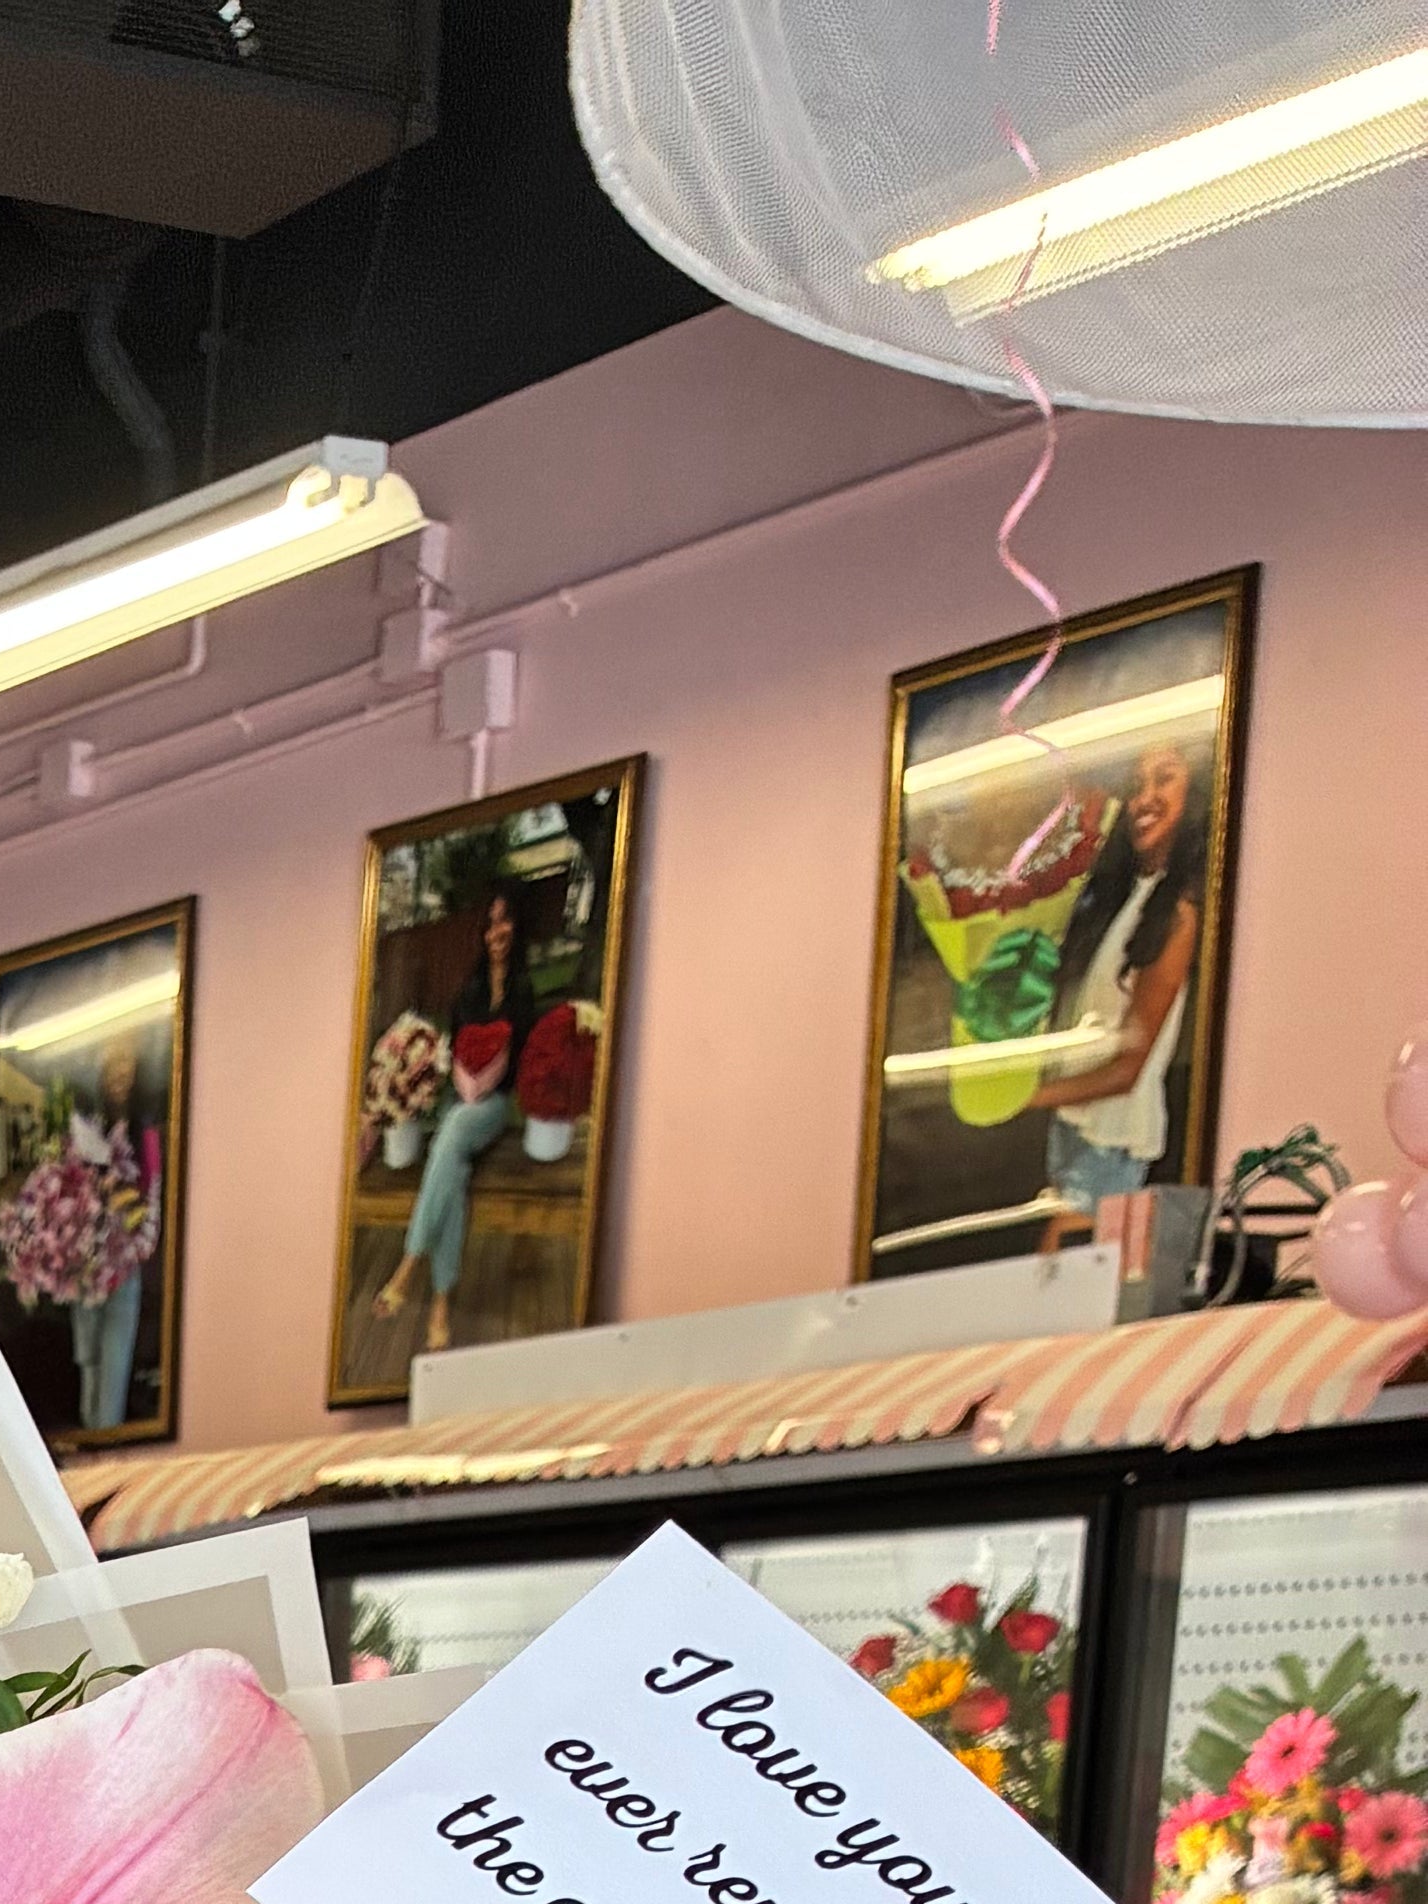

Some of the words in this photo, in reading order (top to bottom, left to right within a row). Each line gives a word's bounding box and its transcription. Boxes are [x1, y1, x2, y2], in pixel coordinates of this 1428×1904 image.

[644, 1648, 734, 1695] I
[696, 1689, 847, 1818] love
[436, 1794, 545, 1896] the
[544, 1739, 681, 1853] ever
